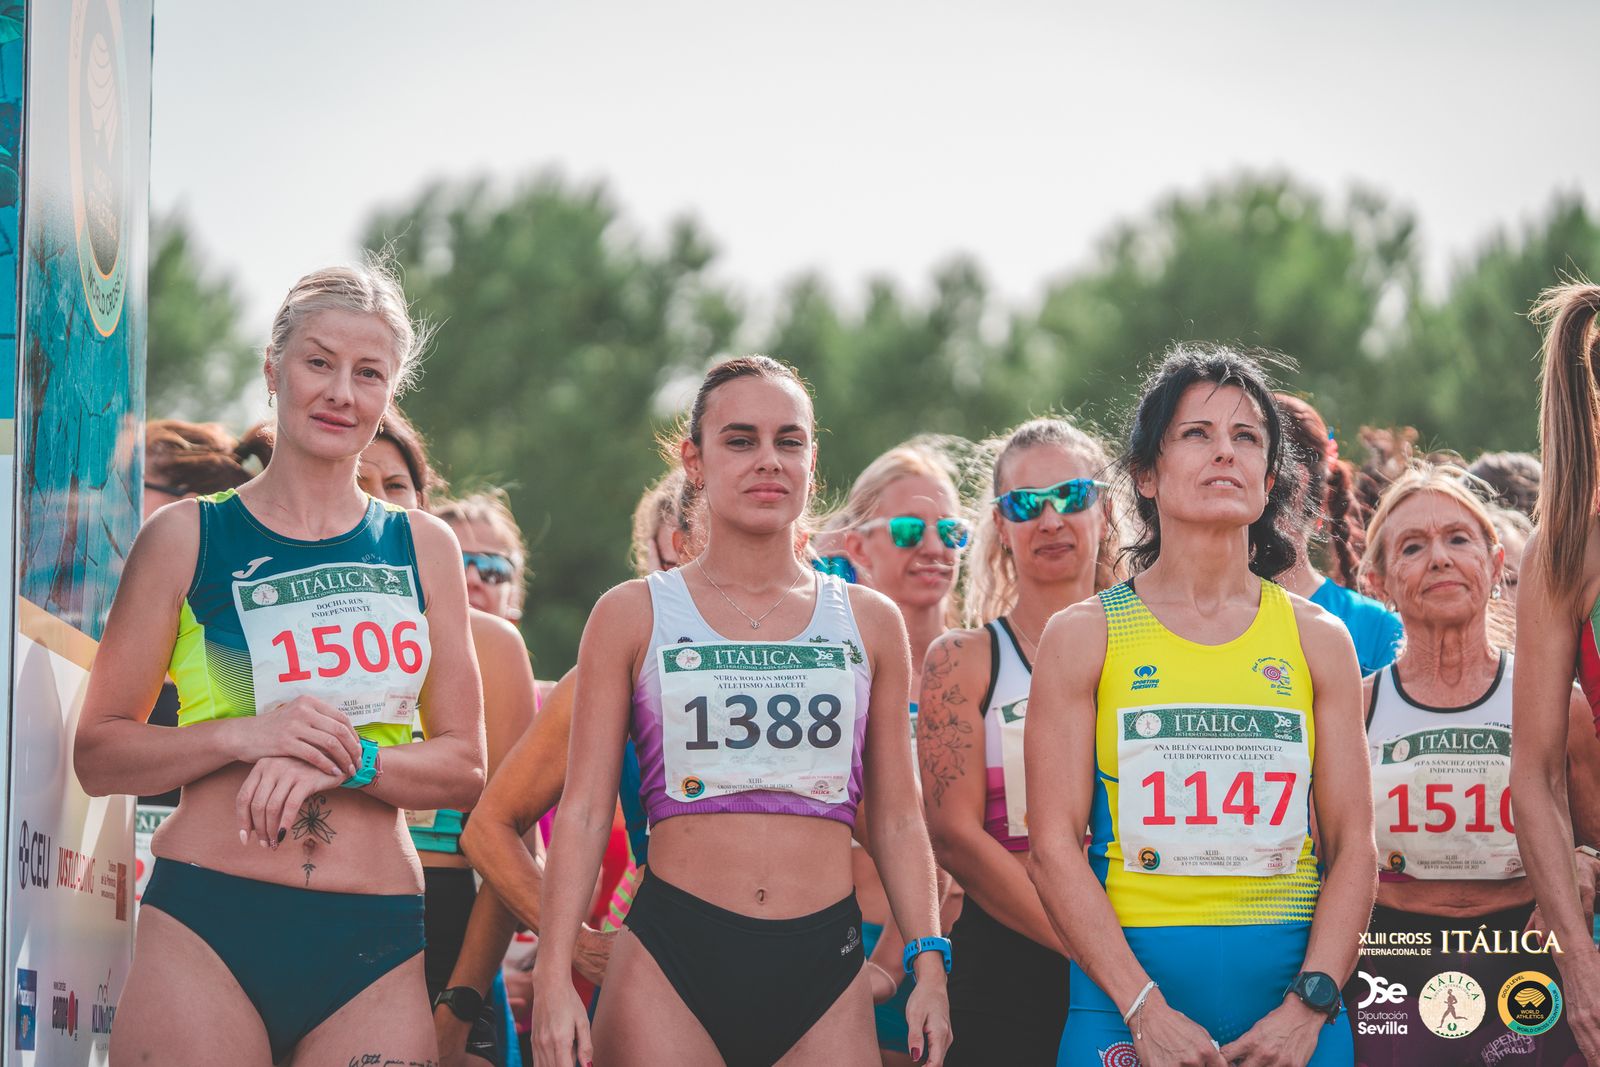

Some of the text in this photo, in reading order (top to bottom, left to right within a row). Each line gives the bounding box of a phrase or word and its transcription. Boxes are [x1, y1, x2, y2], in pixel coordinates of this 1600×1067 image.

[290, 571, 374, 598] ITÁLICA
[312, 606, 372, 618] INDEPENDIENTE
[316, 600, 346, 610] DOCHIA
[272, 620, 423, 683] 1506
[714, 646, 801, 666] ITÁLICA
[684, 694, 842, 750] 1388
[1174, 710, 1260, 732] ITÁLICA
[1172, 743, 1197, 751] BELÉN
[1419, 730, 1498, 750] ITÁLICA
[1142, 770, 1296, 826] 1147
[30, 831, 50, 890] CEU
